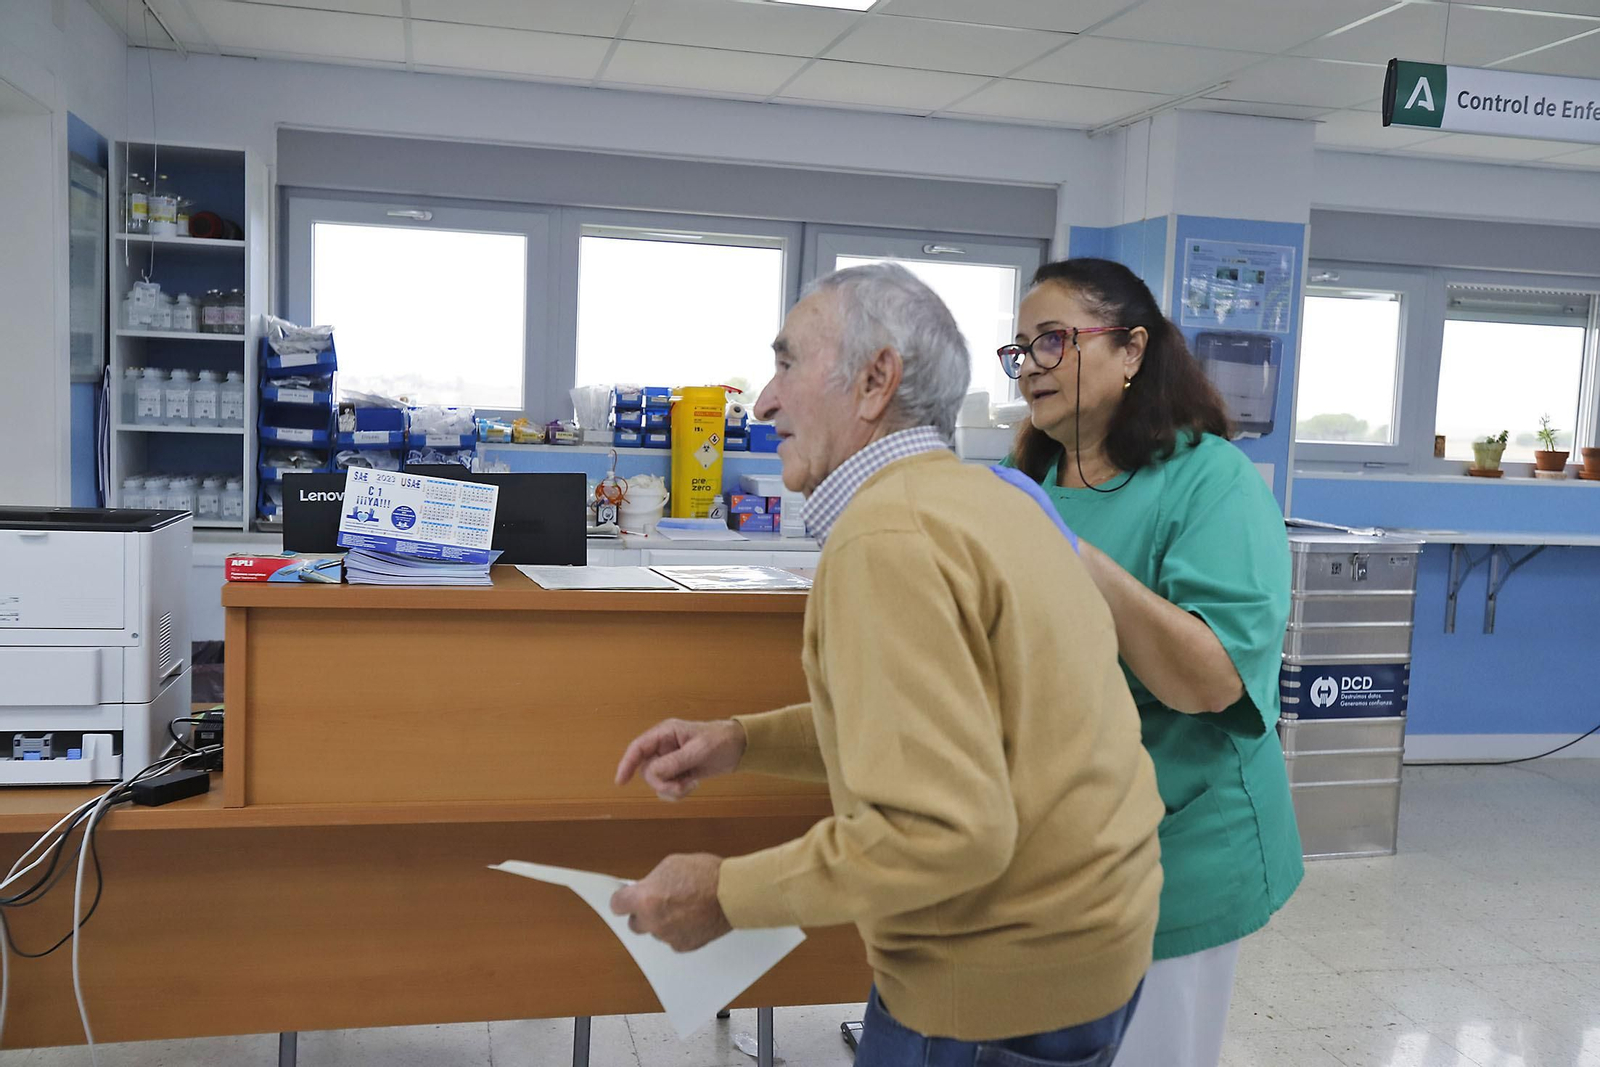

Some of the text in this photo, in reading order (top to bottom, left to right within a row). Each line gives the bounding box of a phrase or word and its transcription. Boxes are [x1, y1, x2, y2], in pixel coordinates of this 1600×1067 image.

[1457, 91, 1600, 121] Control de Enfe
[354, 471, 421, 489] SAE 2023 USAE
[368, 486, 382, 496] C 1
[231, 559, 254, 567] APLI
[1341, 677, 1373, 690] DCD
